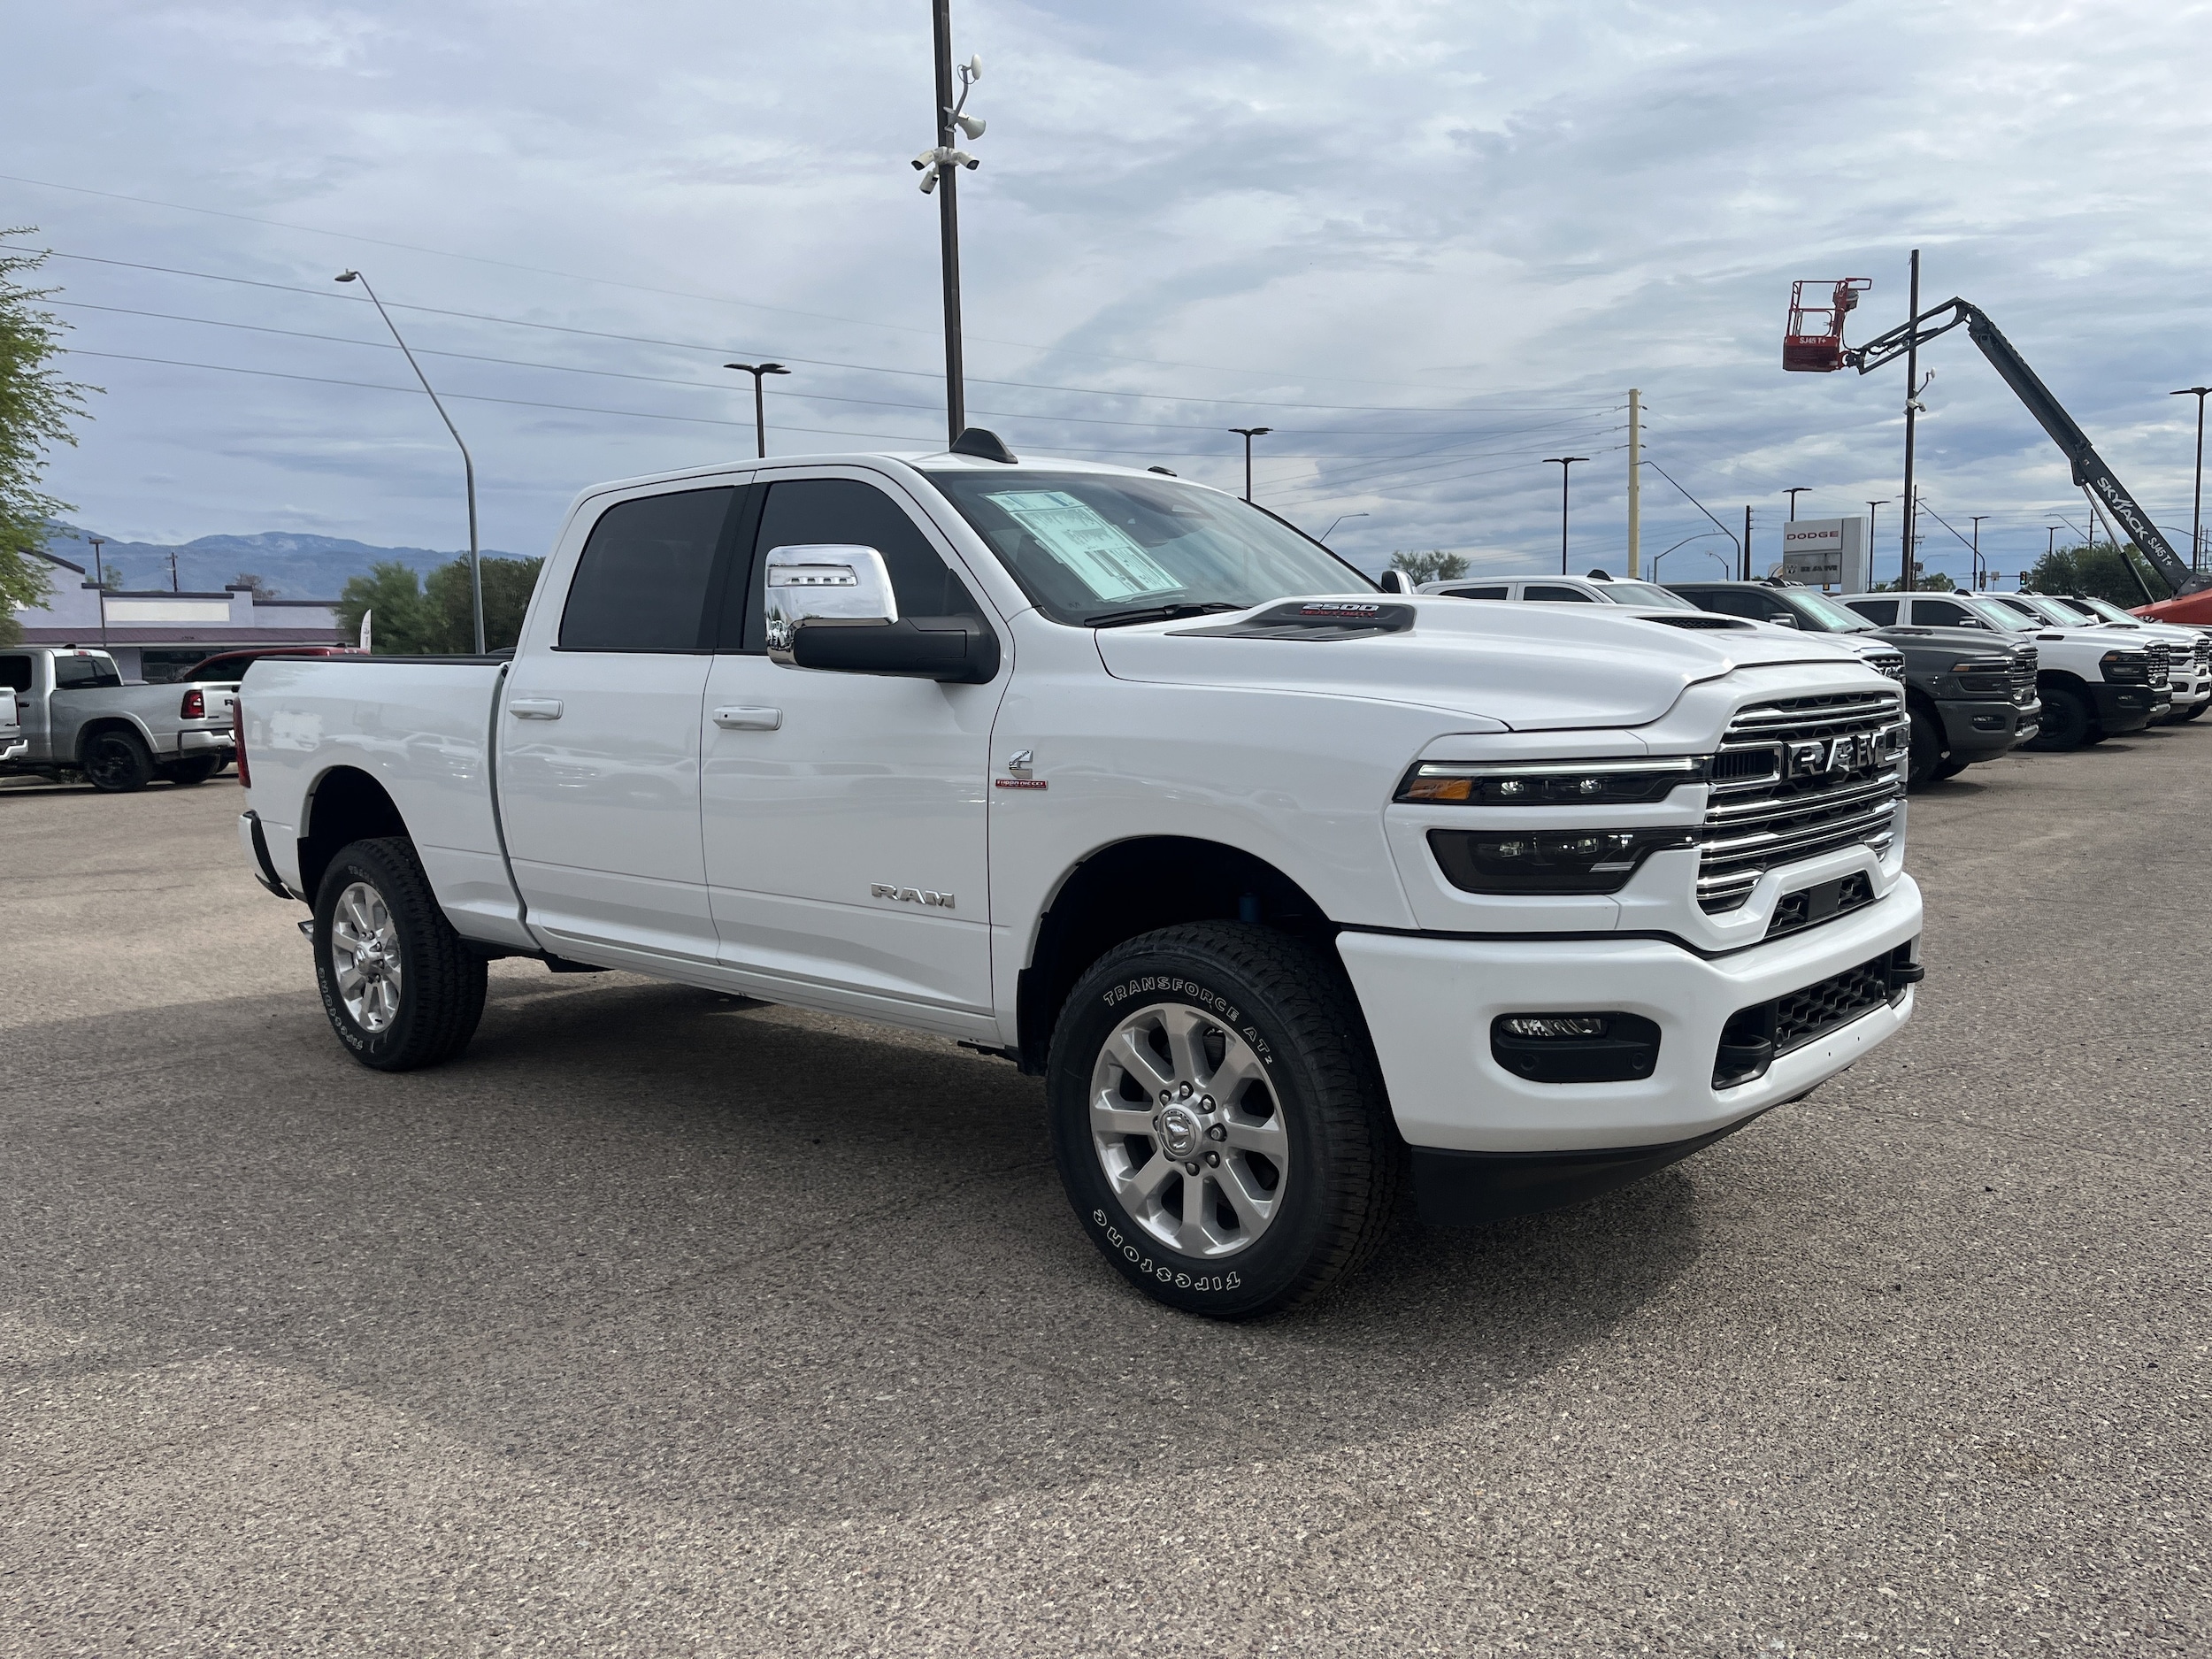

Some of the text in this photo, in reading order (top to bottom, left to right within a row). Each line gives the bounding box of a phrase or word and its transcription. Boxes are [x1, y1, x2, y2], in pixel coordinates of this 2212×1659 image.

[2096, 476, 2149, 541] SKYJACK
[1786, 531, 1839, 540] DODGE
[2147, 536, 2166, 557] SJ45
[1787, 732, 1886, 779] RAM
[871, 883, 956, 909] RAM
[1102, 976, 1240, 1022] TRANSFORCE
